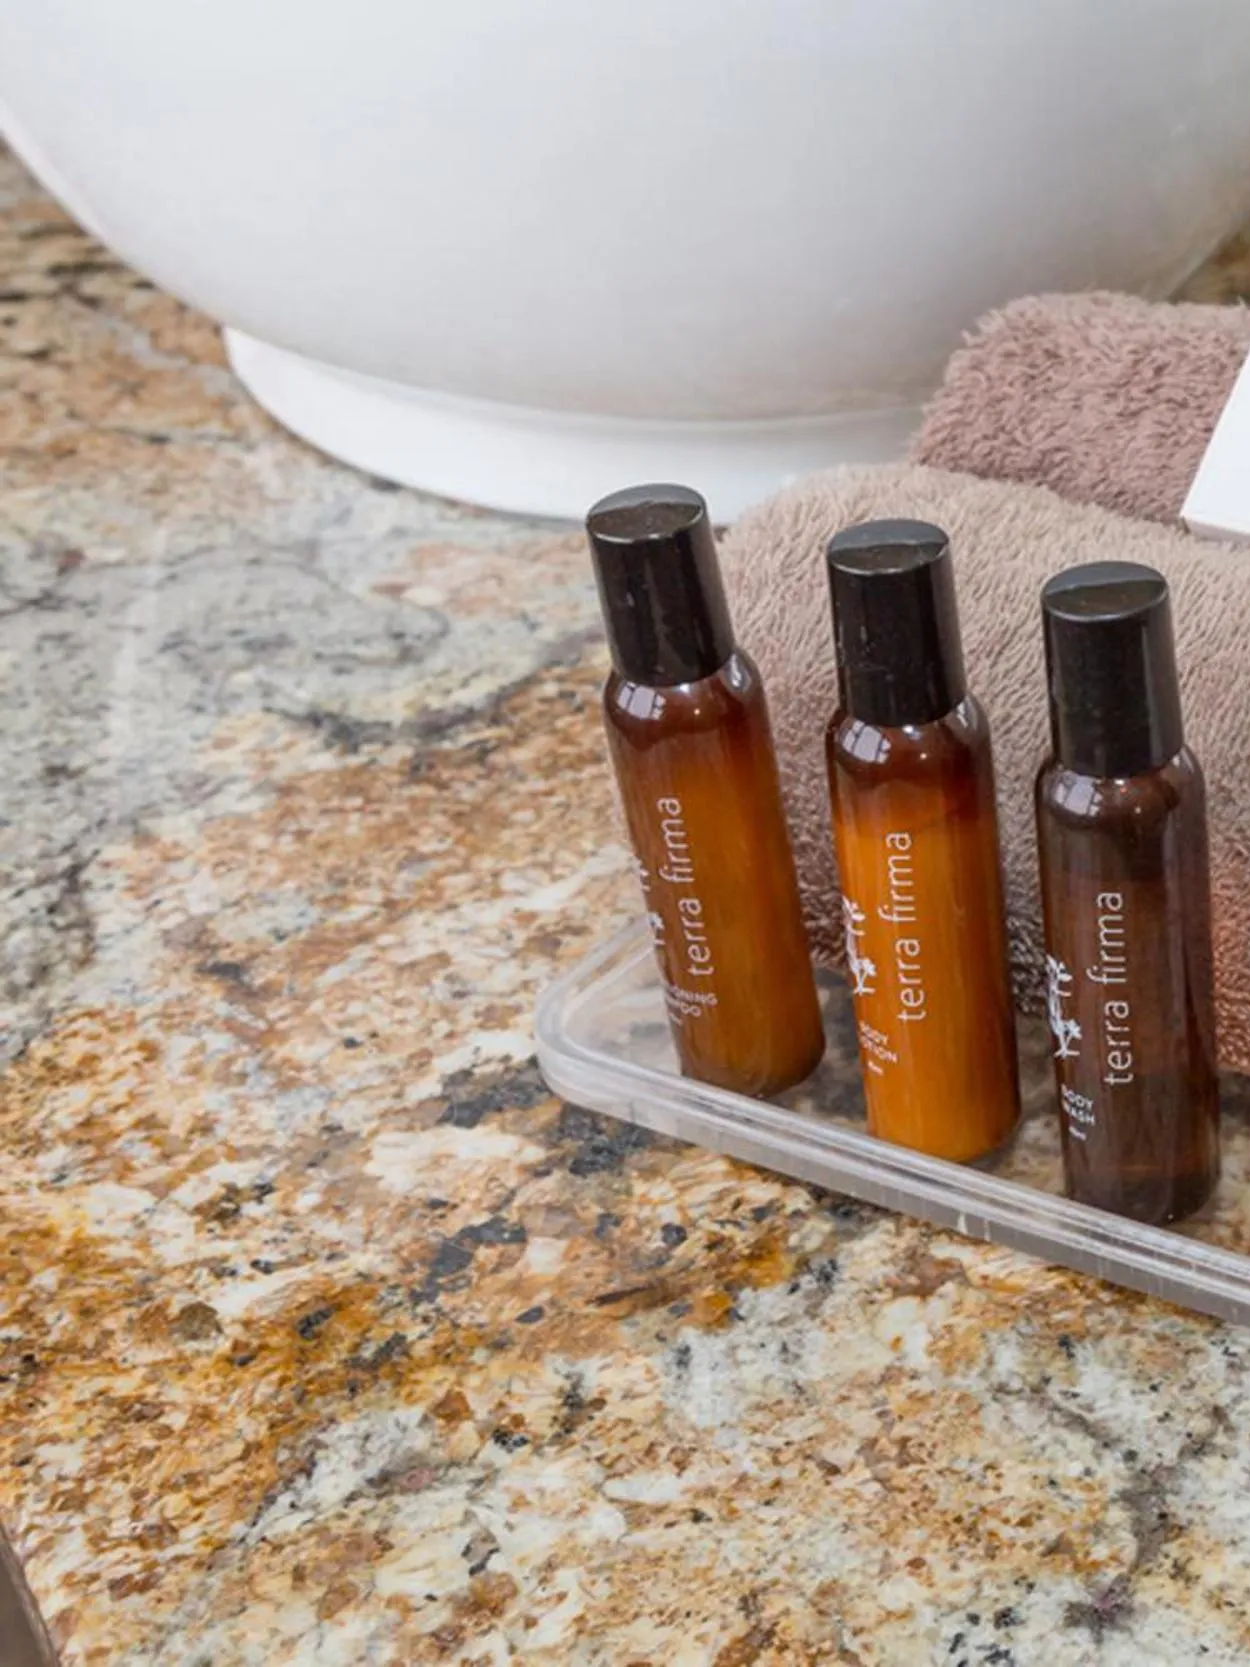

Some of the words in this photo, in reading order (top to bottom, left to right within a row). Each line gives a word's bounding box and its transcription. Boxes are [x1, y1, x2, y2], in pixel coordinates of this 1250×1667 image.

[656, 797, 694, 884] firma
[877, 832, 915, 923] firma
[677, 898, 714, 976] terra
[895, 938, 926, 1022] terra
[1086, 891, 1126, 985] firma
[1103, 1000, 1133, 1085] terra
